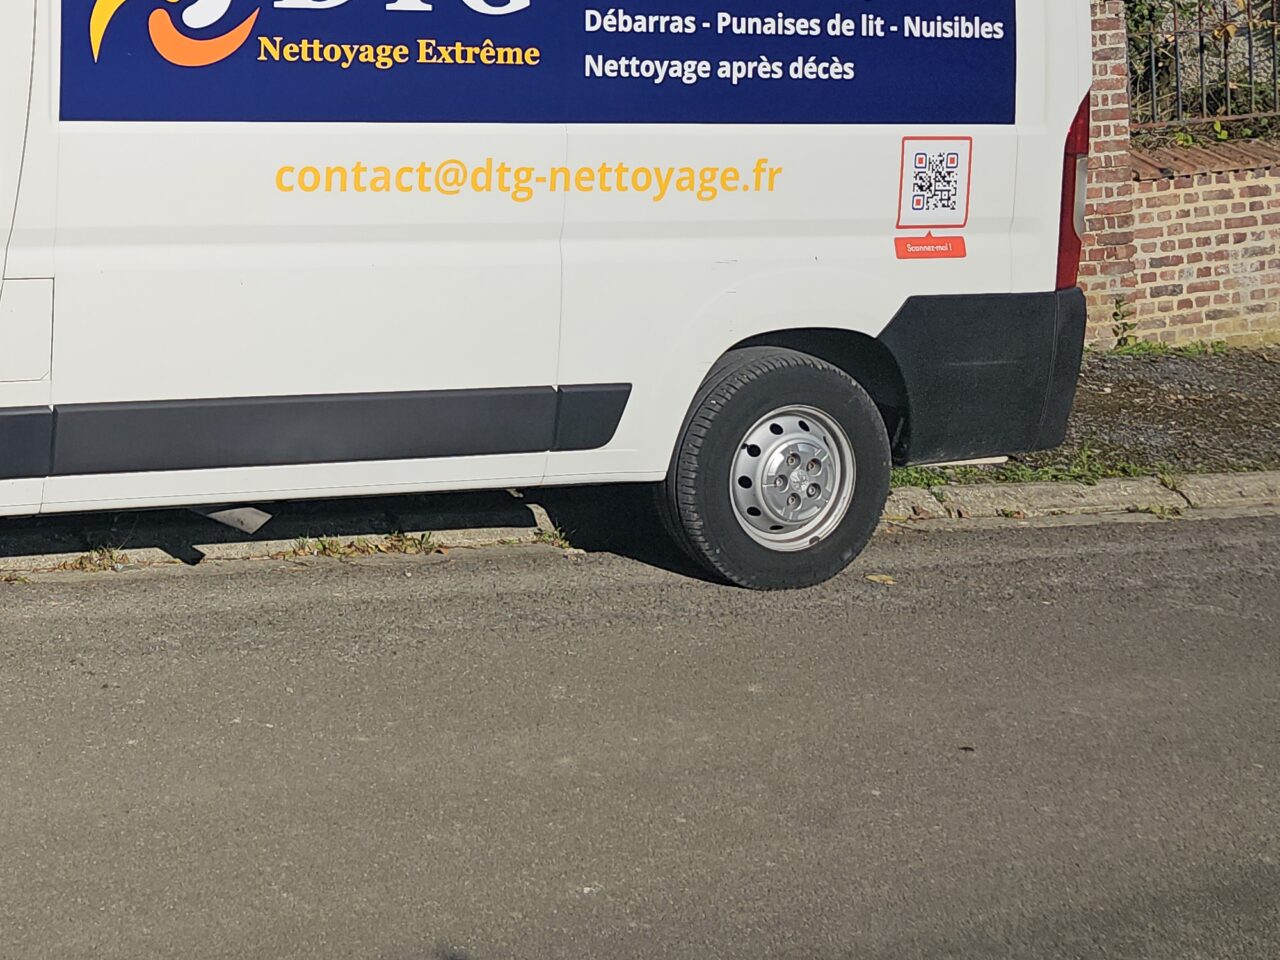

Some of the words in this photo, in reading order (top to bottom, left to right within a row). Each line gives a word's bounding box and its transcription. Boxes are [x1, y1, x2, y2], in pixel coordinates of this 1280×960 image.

[585, 8, 696, 34] Débarras
[717, 12, 821, 36] Punaises
[826, 13, 855, 37] de
[861, 13, 885, 37] lit
[903, 15, 1004, 39] Nuisibles
[258, 36, 409, 69] Nettoyage
[417, 39, 540, 66] Extrême
[585, 54, 711, 85] Nettoyage
[717, 55, 783, 85] après
[789, 56, 855, 81] décès
[274, 156, 783, 203] contact@dtg-nettoyage.fr
